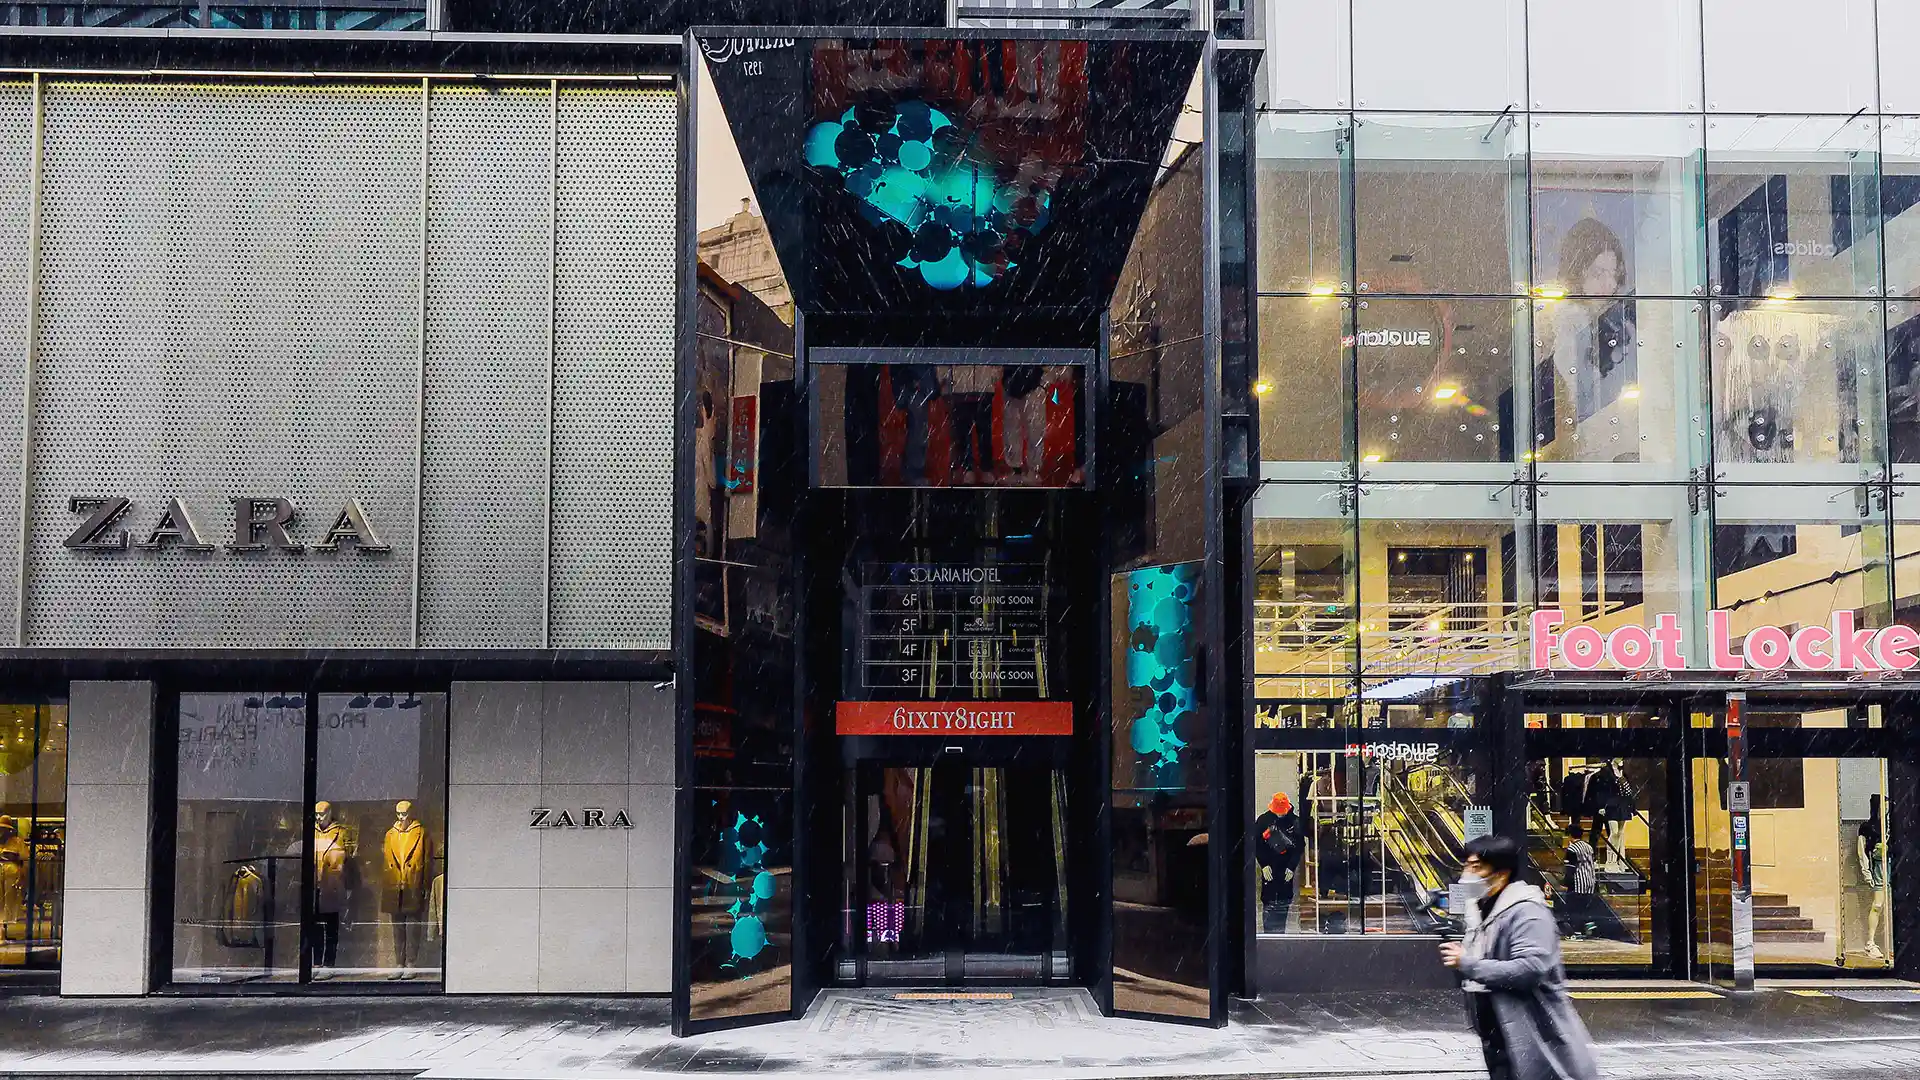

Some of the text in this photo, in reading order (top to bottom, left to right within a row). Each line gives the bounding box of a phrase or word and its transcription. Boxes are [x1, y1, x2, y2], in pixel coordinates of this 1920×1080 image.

[63, 497, 391, 551] ZARA
[909, 567, 1001, 583] SOLARIA HOTEL
[902, 594, 918, 607] 6F
[969, 595, 1034, 605] COMING SOON
[902, 618, 918, 632] 5F
[1529, 609, 1686, 670] Foot
[902, 643, 918, 656] 4F
[901, 669, 918, 682] 3F
[969, 671, 1034, 681] COMING SOON
[893, 706, 1016, 729] 6IXTY8IGHT
[529, 808, 636, 829] ZARA
